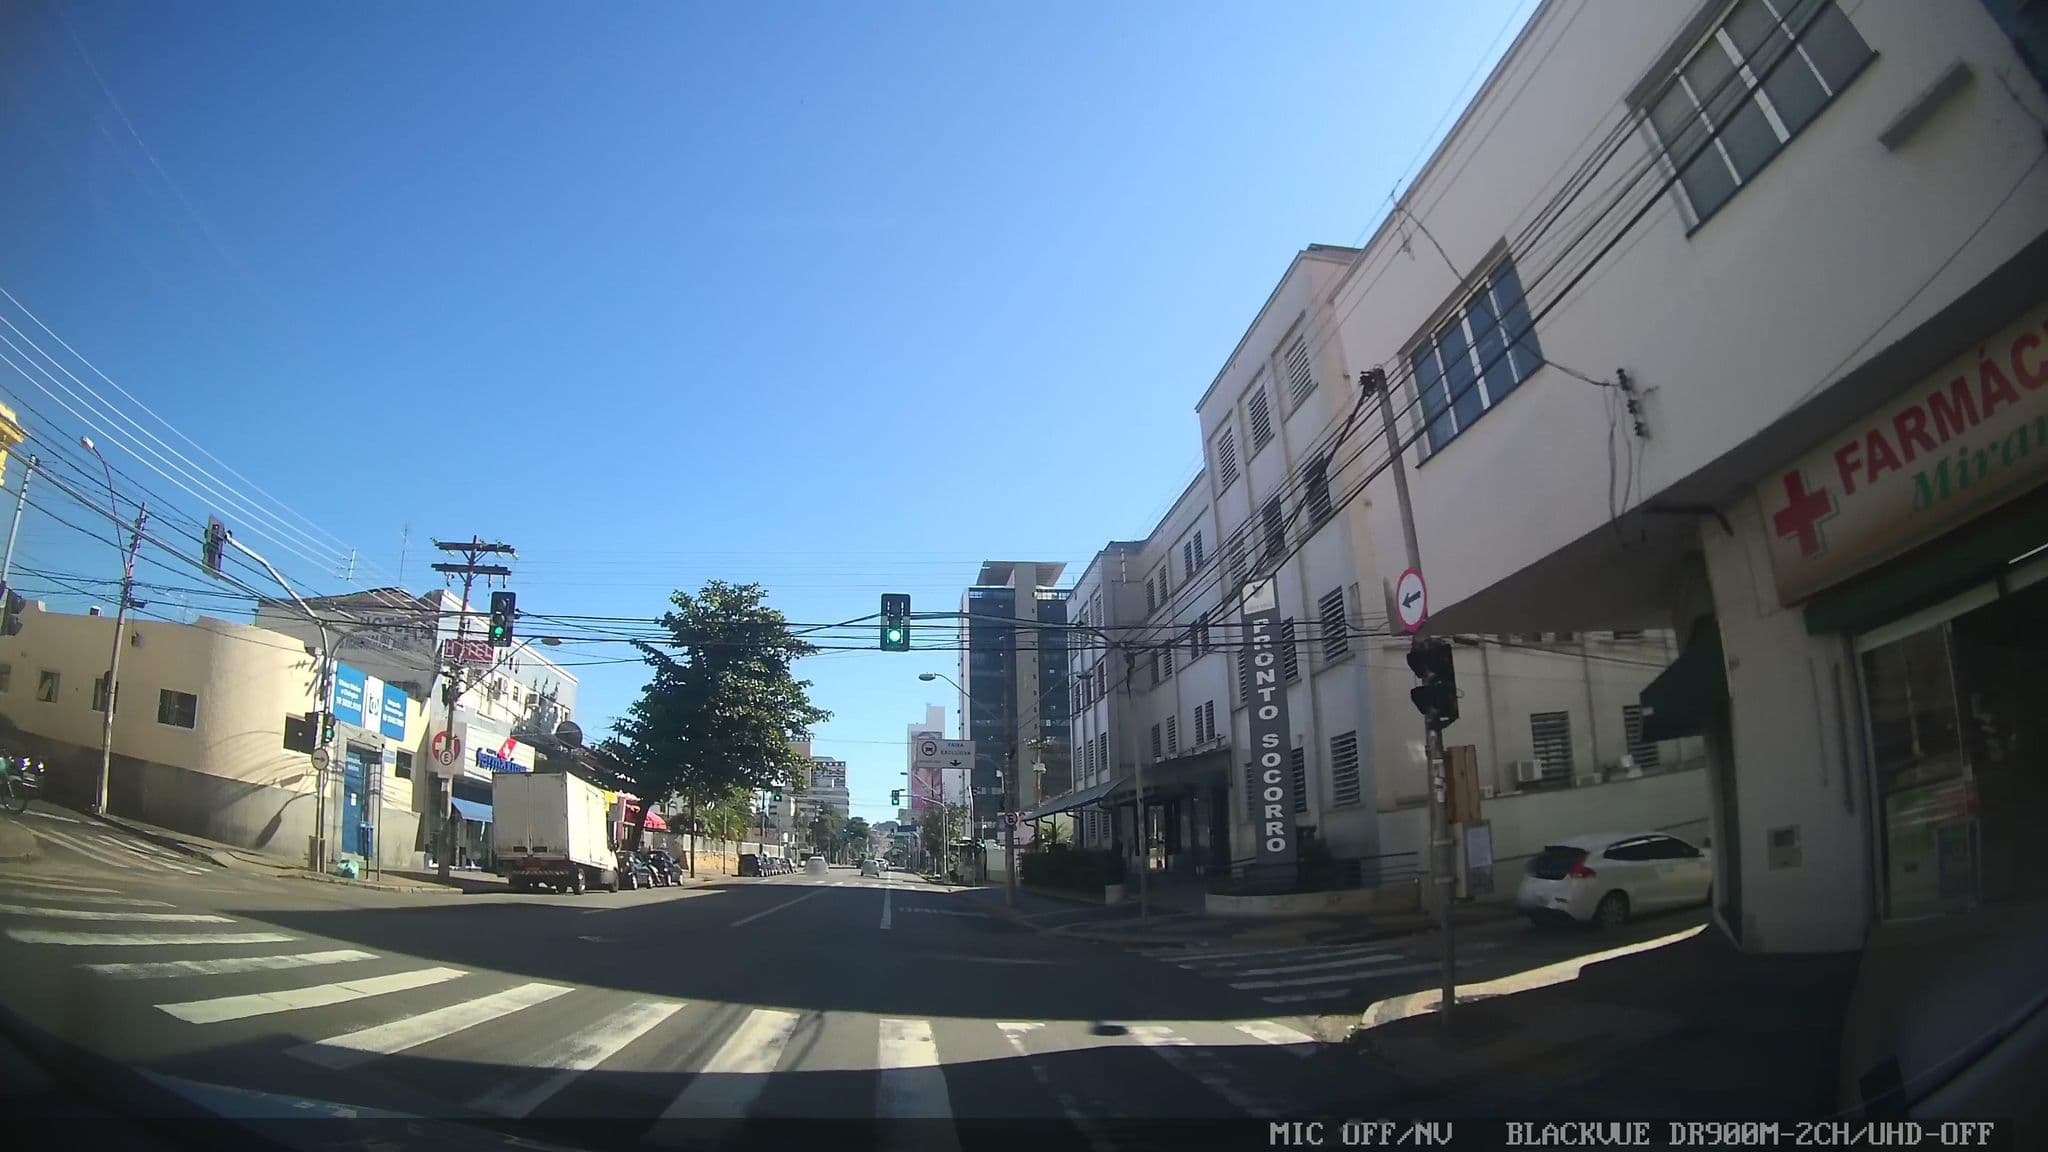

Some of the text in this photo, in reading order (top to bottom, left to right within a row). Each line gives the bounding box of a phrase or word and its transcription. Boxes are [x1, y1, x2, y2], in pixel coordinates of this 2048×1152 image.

[1834, 319, 2048, 495] FARMÁC
[446, 640, 493, 658] HTEL
[1252, 618, 1279, 721] PRONTO
[1261, 733, 1286, 853] SOCORRO
